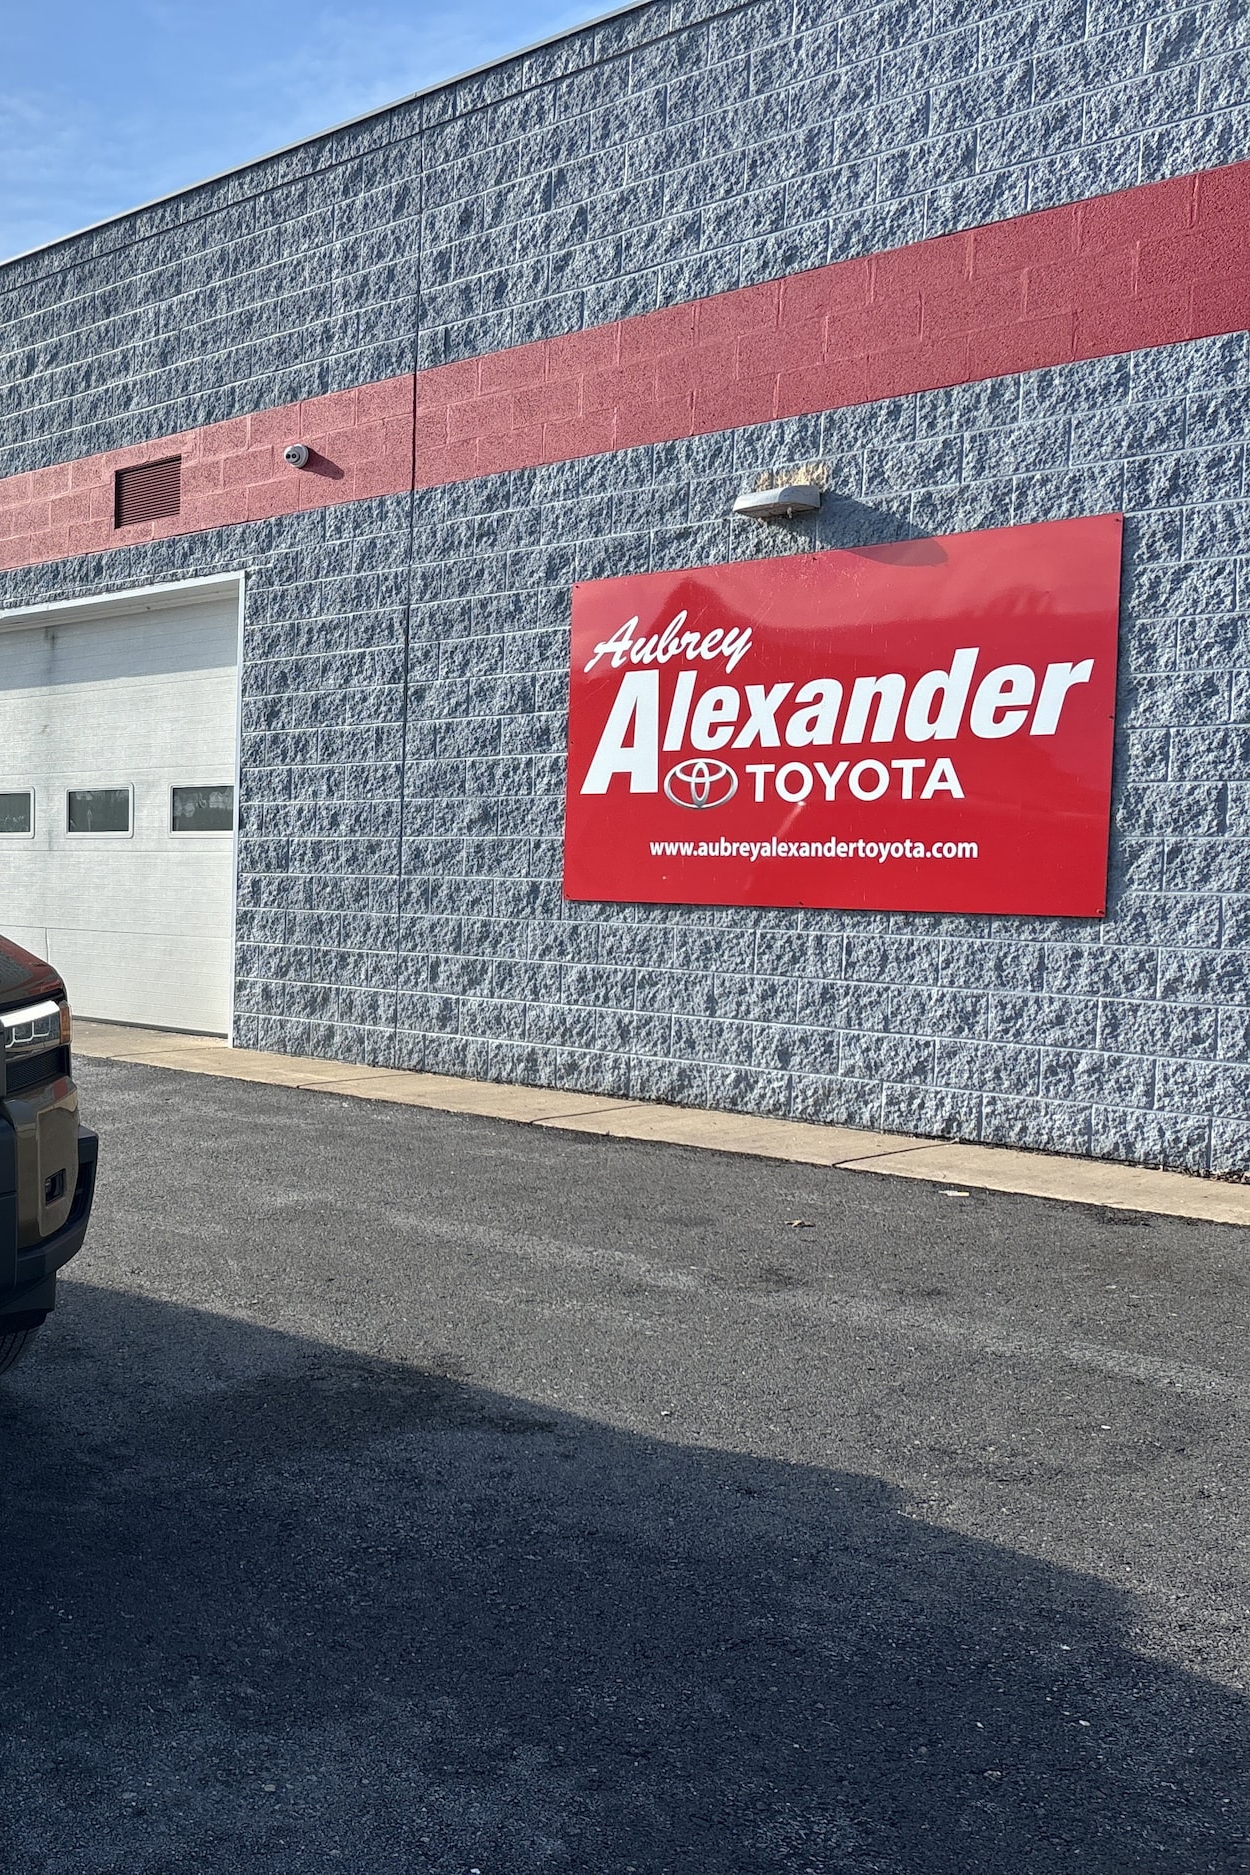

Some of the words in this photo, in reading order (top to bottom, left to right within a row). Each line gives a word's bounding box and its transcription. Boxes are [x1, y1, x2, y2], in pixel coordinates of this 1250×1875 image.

[583, 609, 753, 674] Aubrey
[579, 646, 1095, 795] Alexander
[745, 757, 966, 803] TOYOTA
[649, 836, 979, 864] www.aubreyalexandertoyota.com
